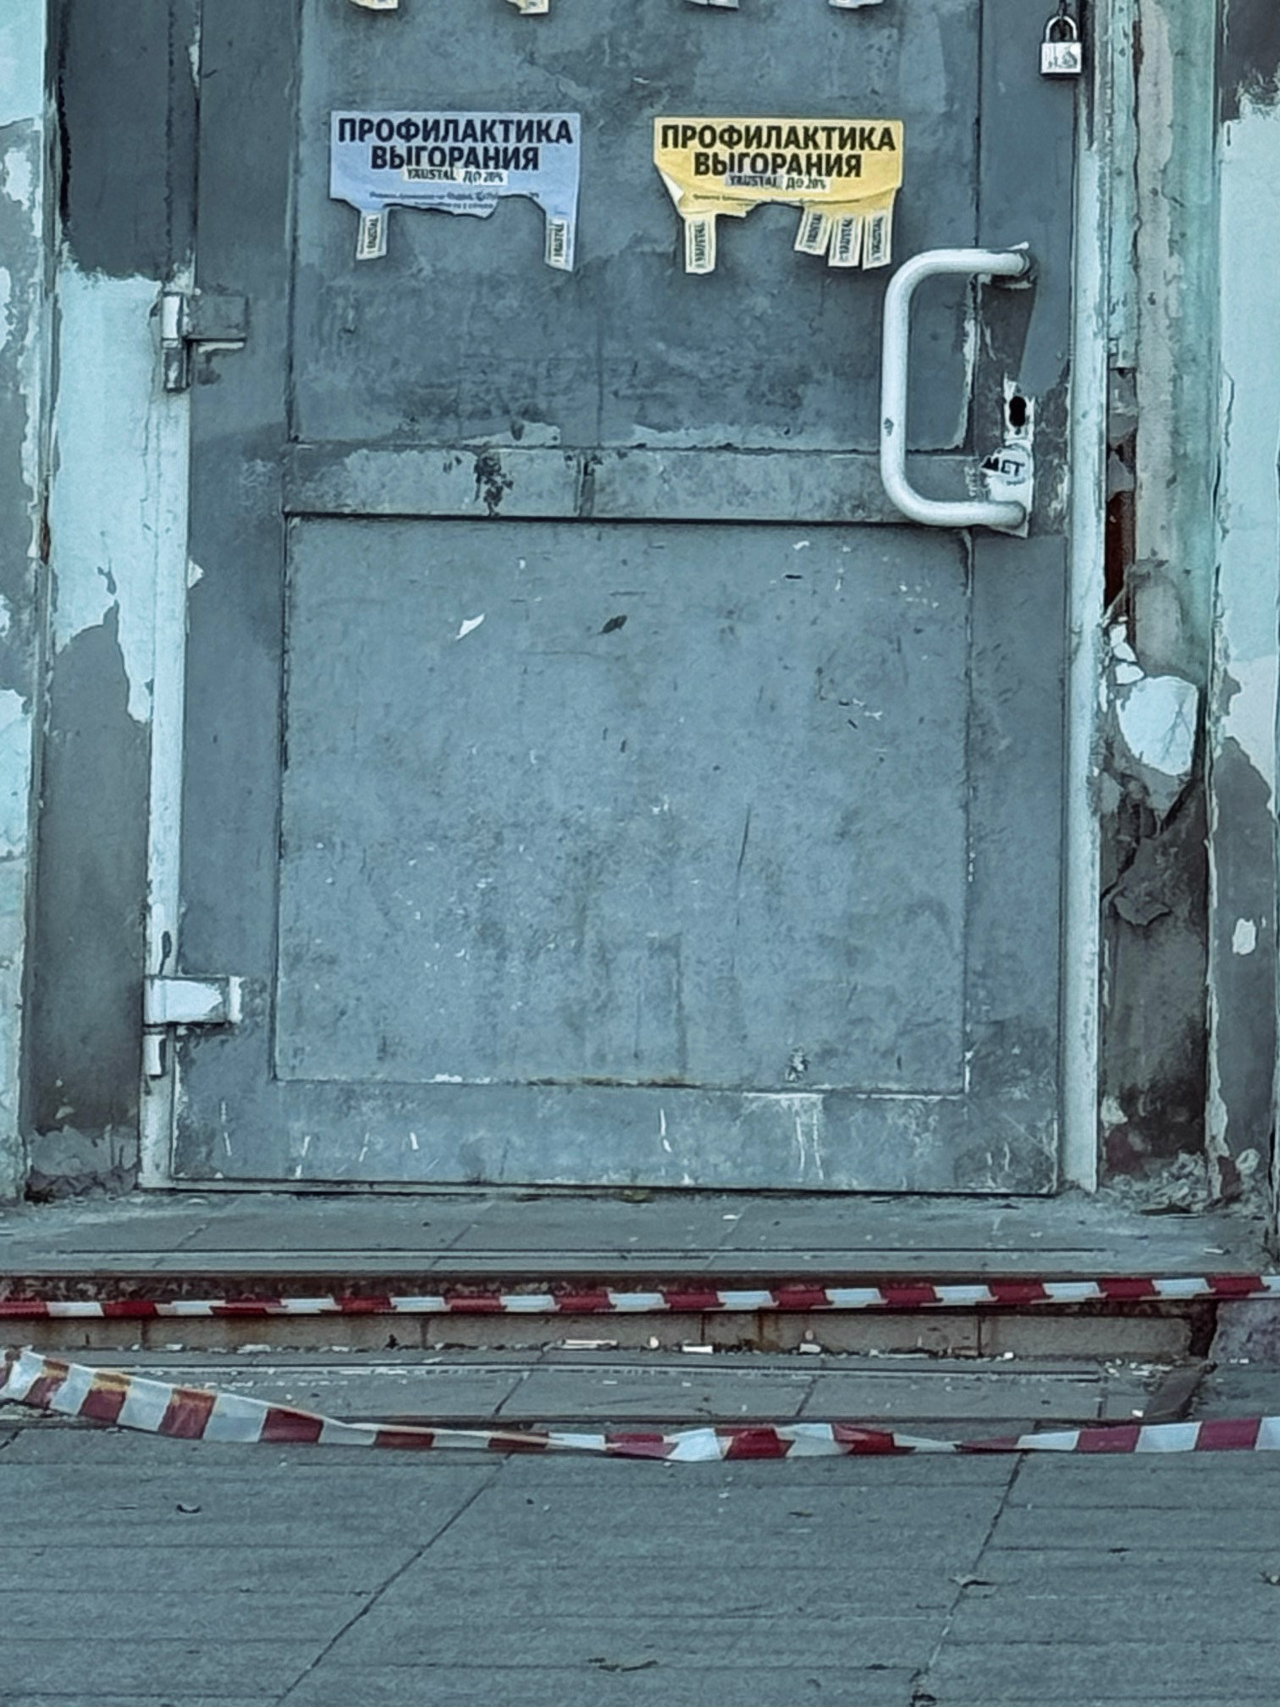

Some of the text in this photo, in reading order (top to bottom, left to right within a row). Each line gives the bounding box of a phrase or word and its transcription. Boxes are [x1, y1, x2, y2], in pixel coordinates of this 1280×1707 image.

[338, 118, 573, 144] ПРОФИЛАКТИКА
[661, 124, 896, 151] ПРОФИЛАКТИКА
[371, 146, 539, 171] ВЫГОРАНИЯ
[694, 152, 862, 178] ВЫГОРАНИЯ
